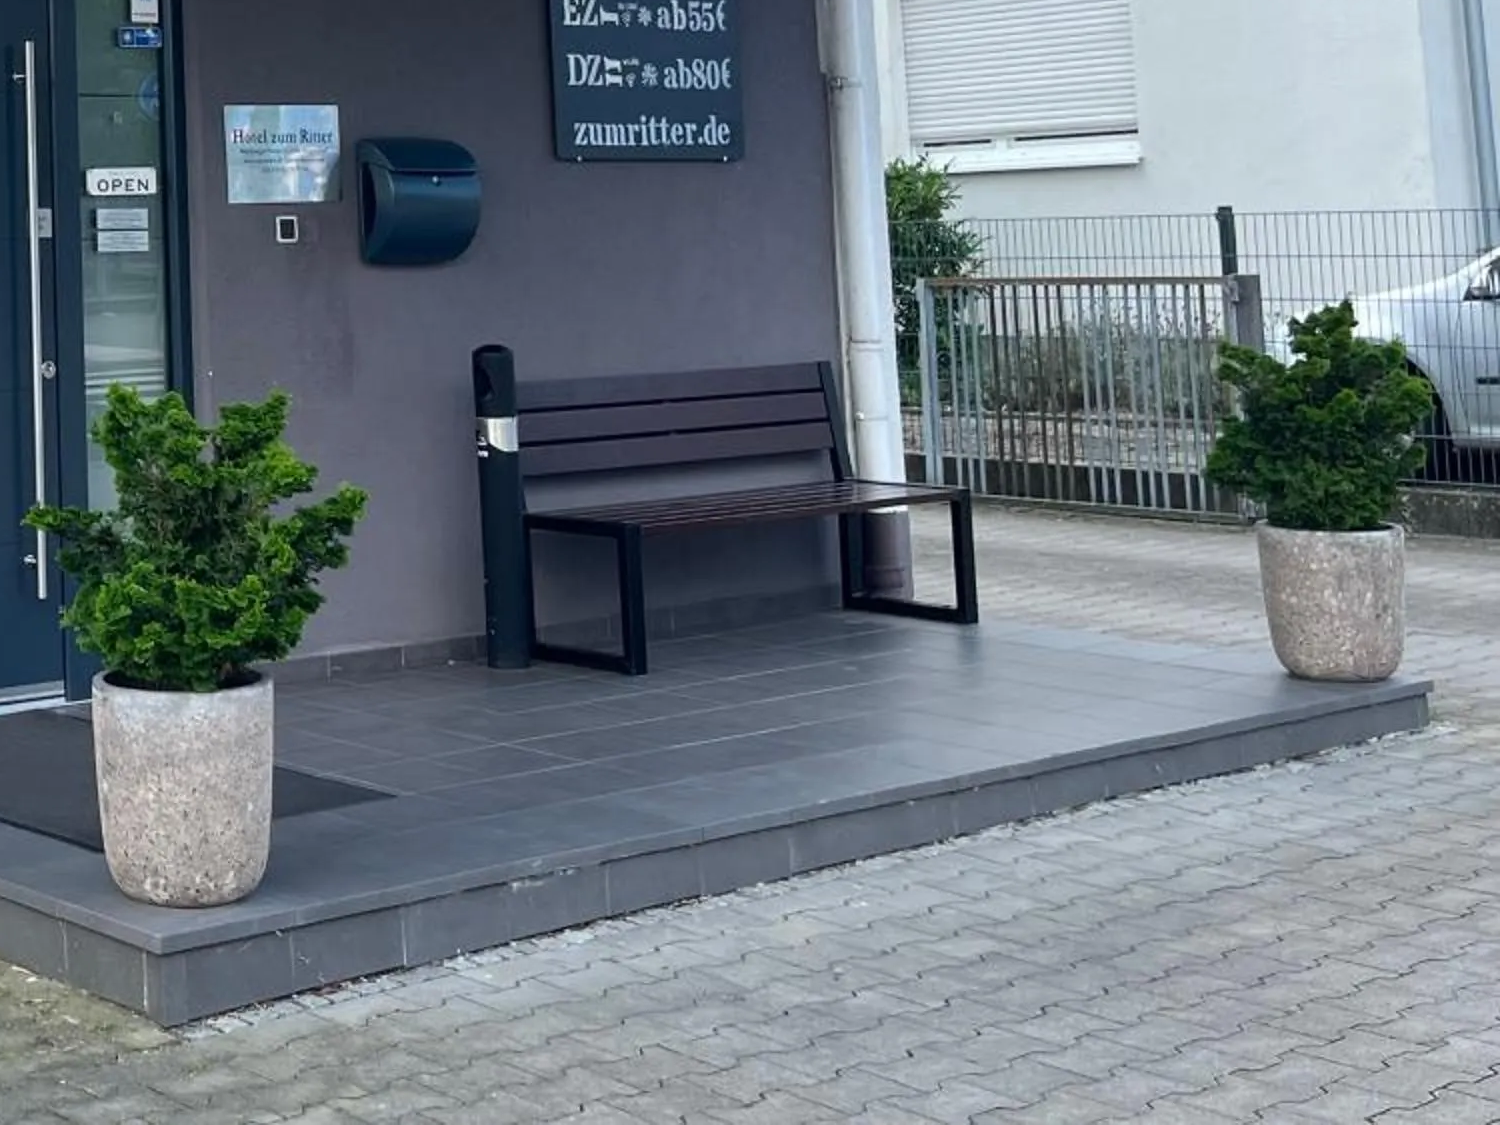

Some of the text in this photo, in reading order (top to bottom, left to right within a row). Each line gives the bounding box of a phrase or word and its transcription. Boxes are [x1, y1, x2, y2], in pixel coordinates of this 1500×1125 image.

[566, 53, 603, 86] DZ
[573, 114, 731, 146] zumritter.de
[97, 178, 149, 192] OPEN
